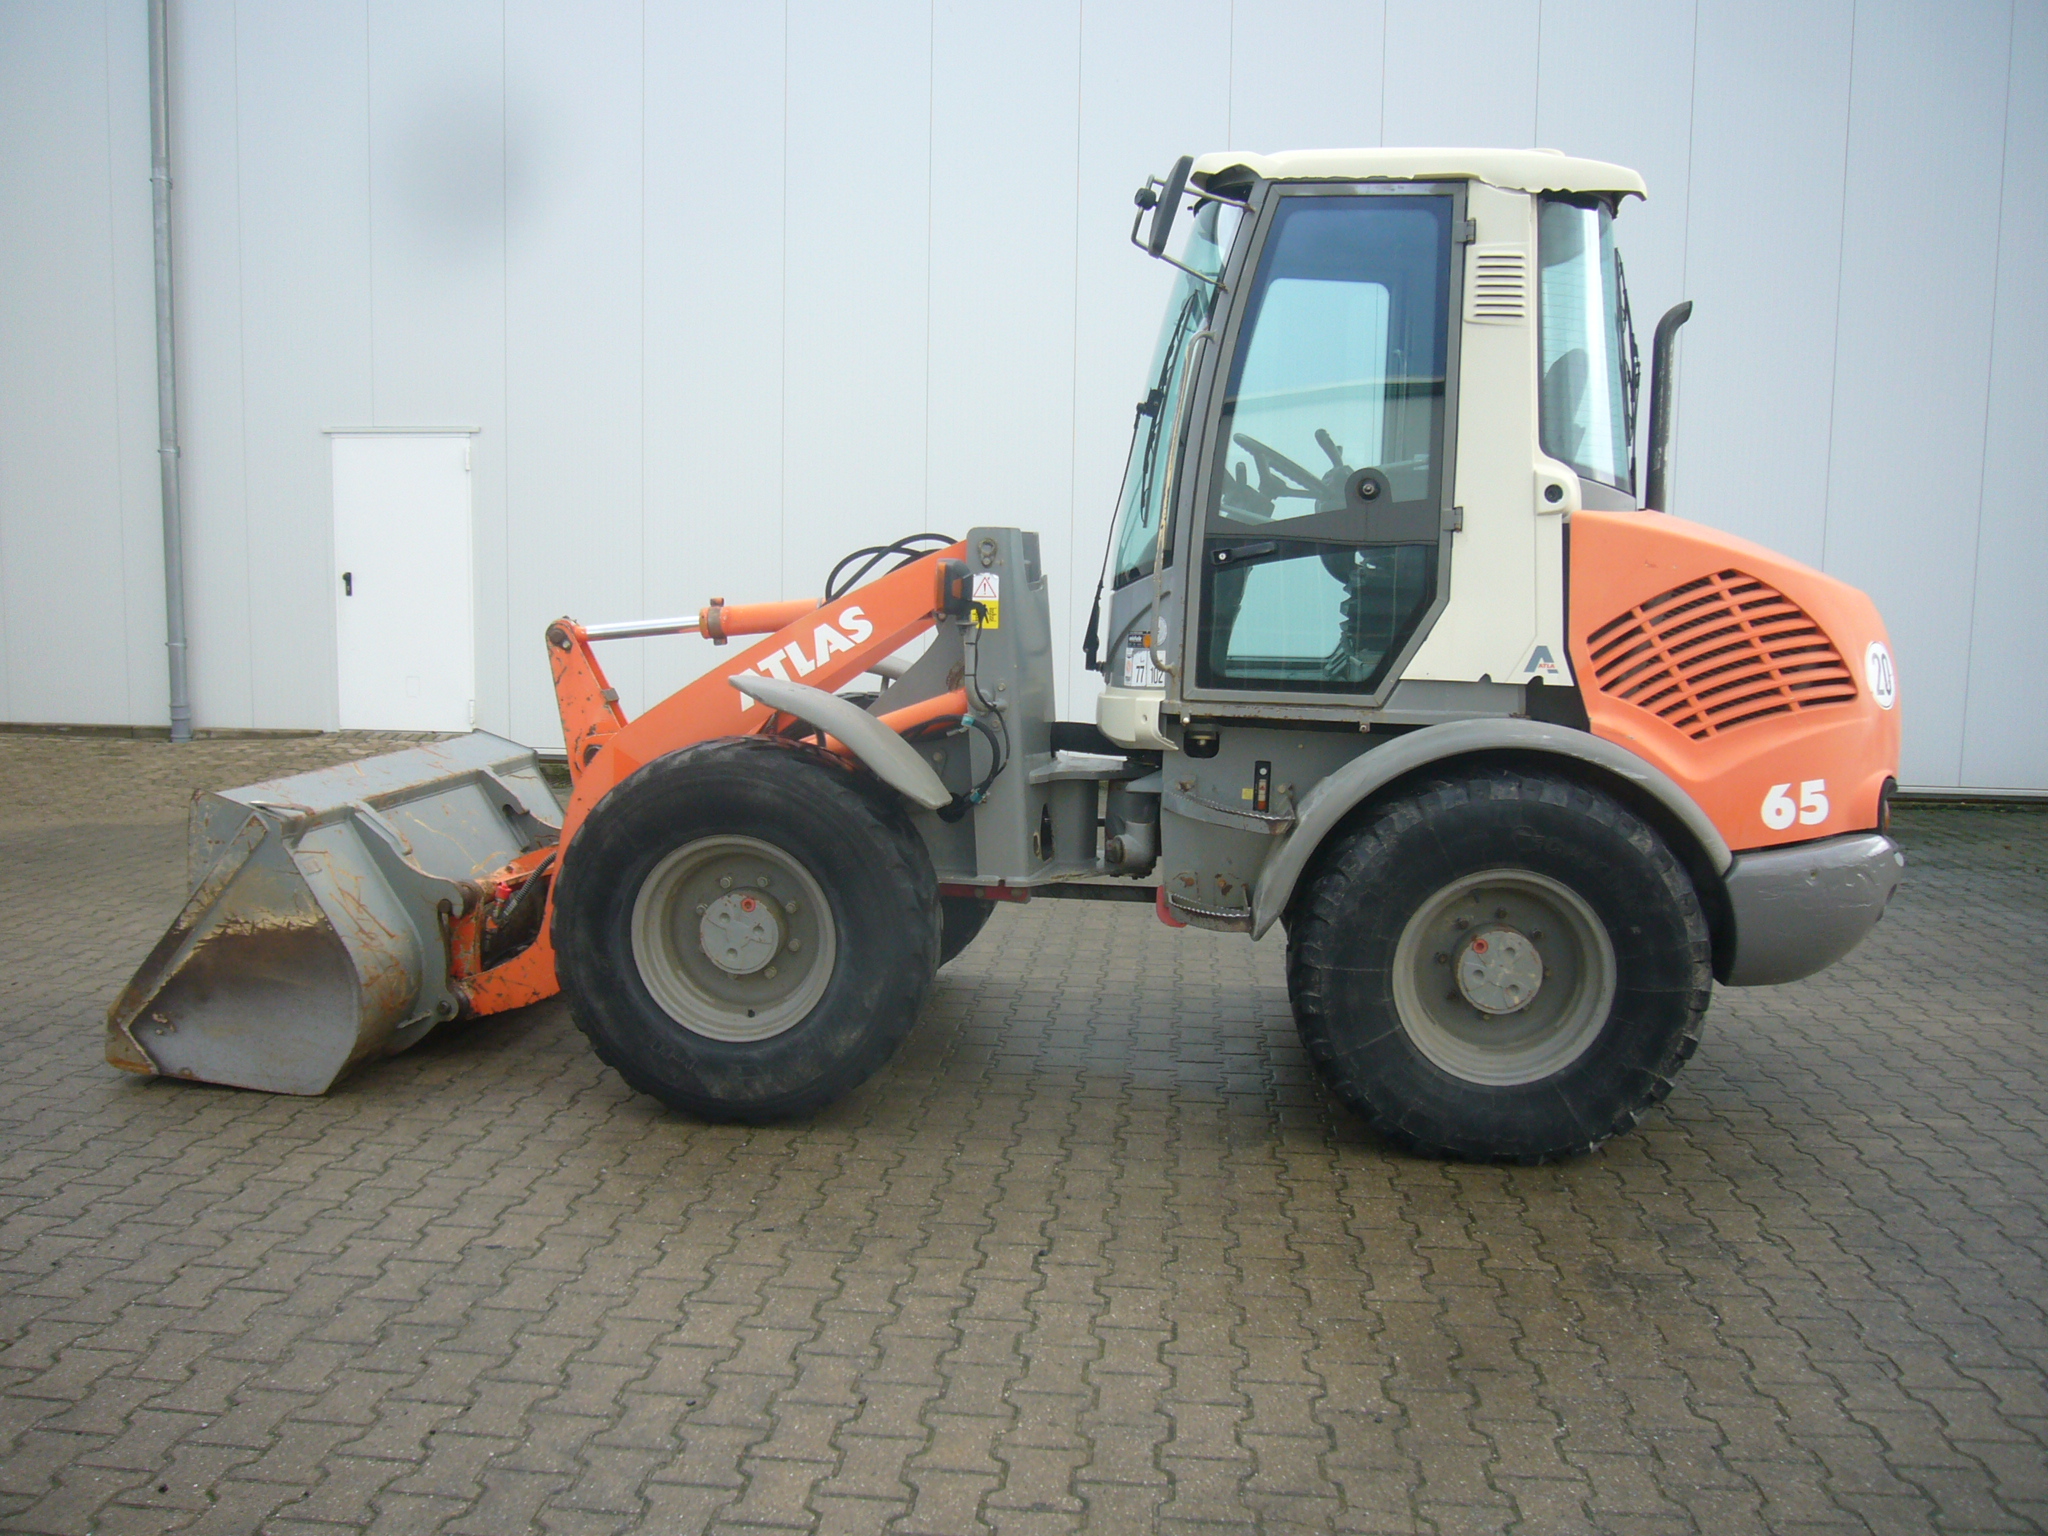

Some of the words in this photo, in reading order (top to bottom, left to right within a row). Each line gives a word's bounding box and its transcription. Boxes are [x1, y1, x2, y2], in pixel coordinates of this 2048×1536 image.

[1136, 665, 1145, 683] 77
[1871, 653, 1892, 696] 20
[1761, 779, 1829, 830] 65
